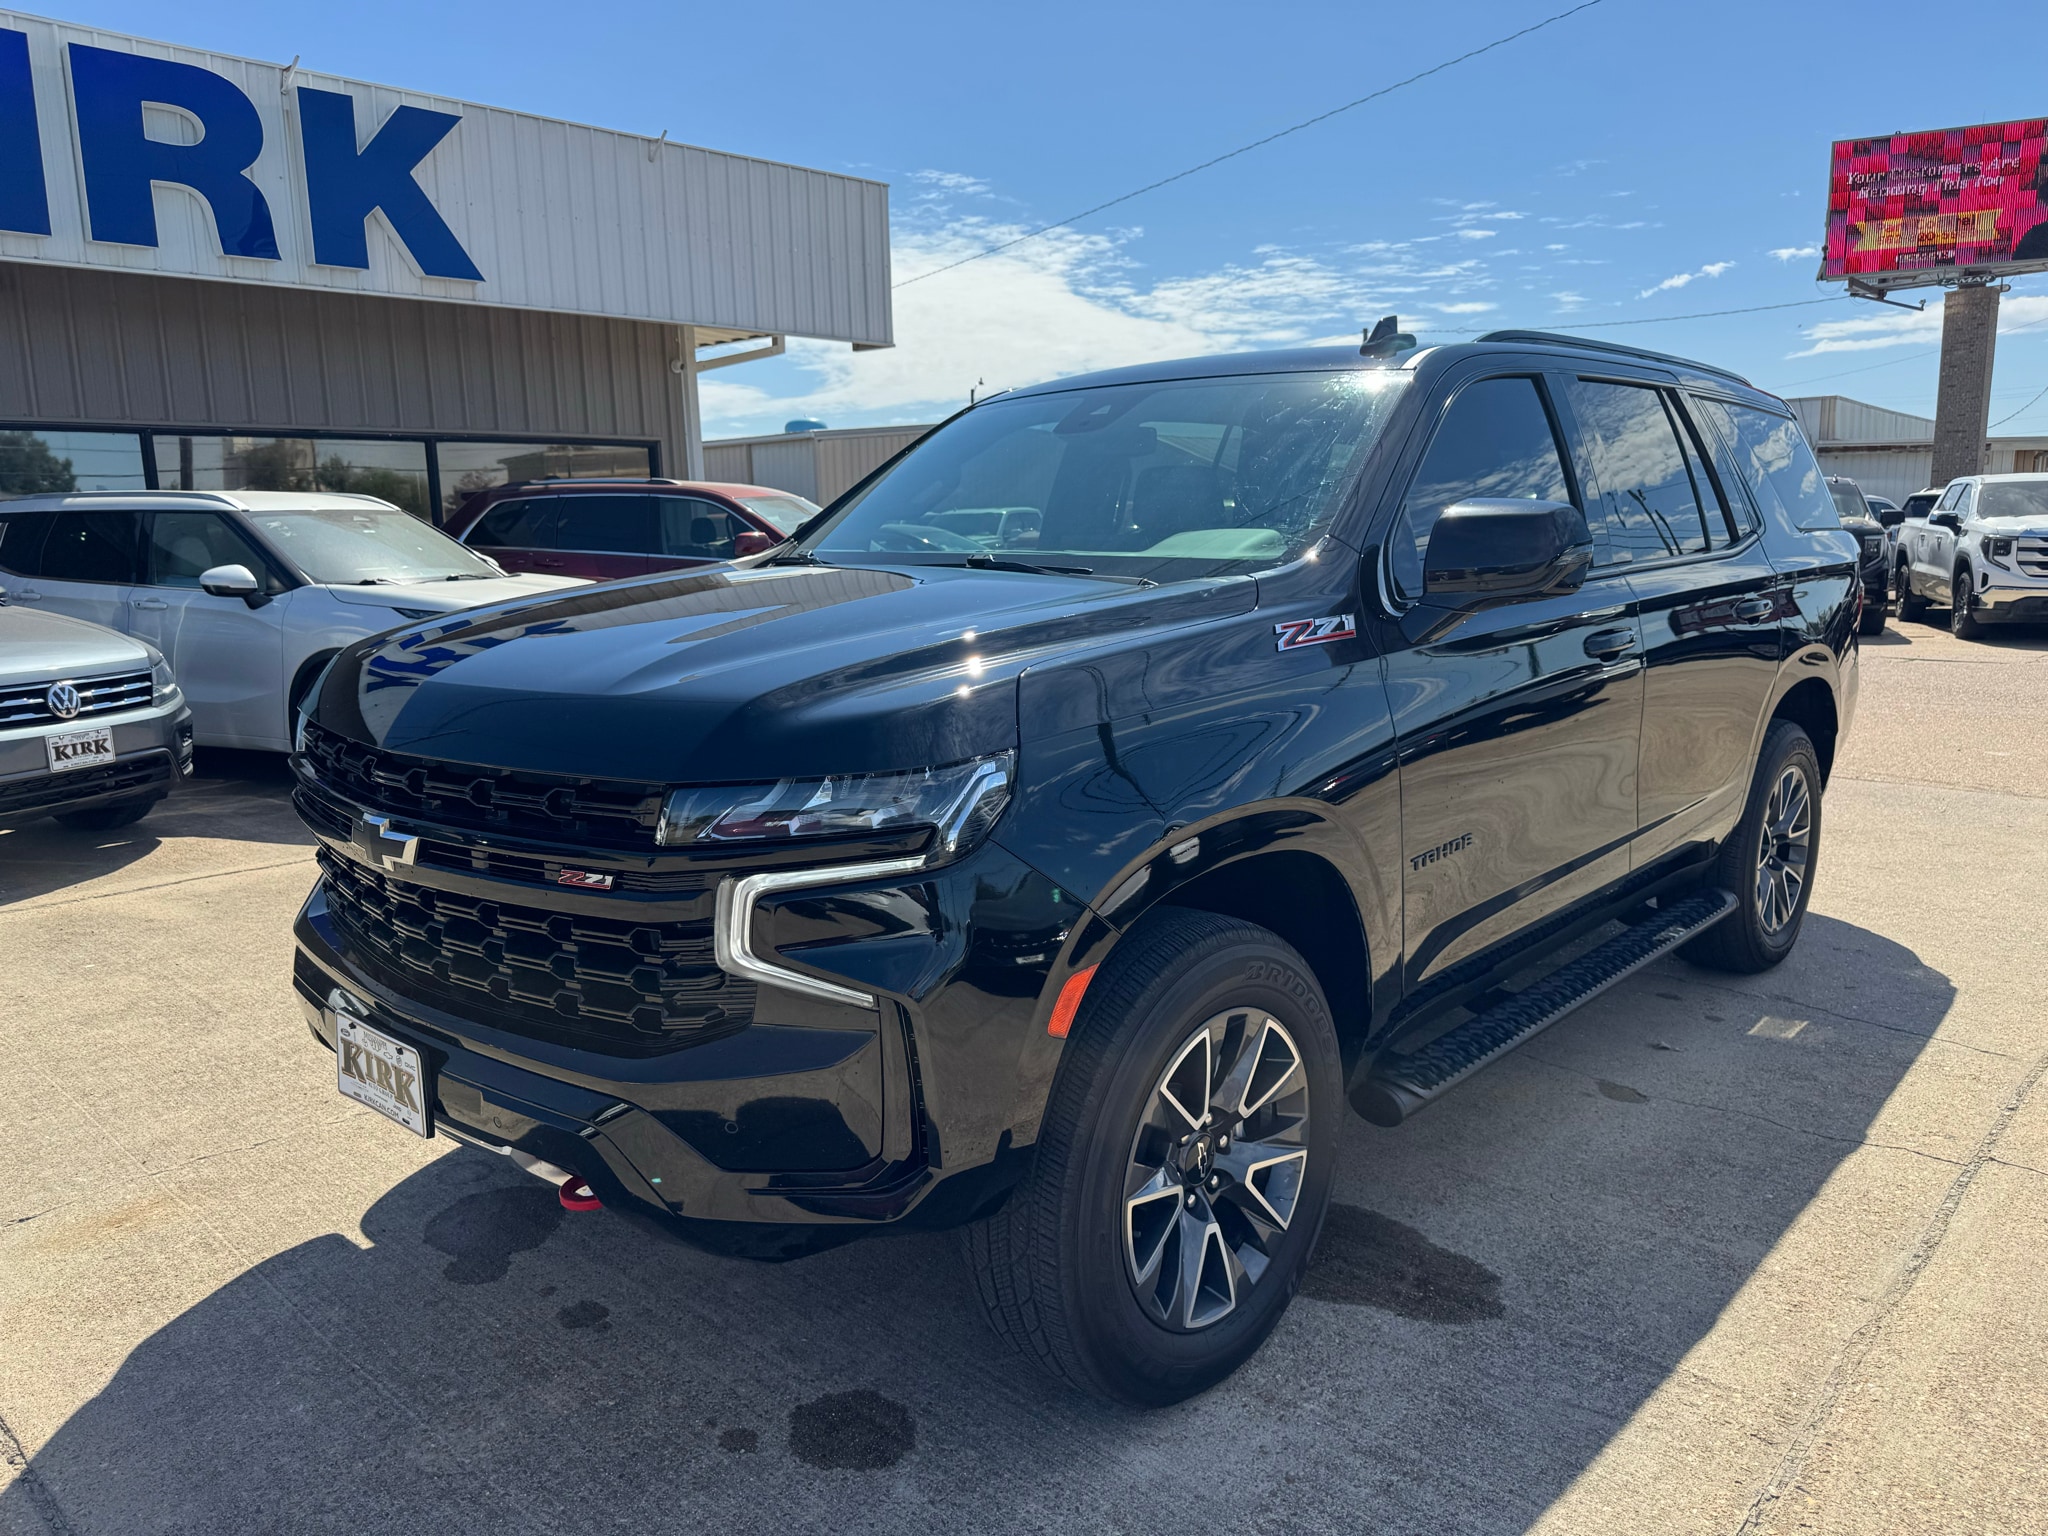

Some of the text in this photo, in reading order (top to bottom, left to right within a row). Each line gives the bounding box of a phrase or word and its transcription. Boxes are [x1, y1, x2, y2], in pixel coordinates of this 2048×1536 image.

[1846, 156, 2021, 185] Your Customers Are
[1856, 182, 1928, 199] Reading
[1934, 176, 1968, 192] This
[1941, 275, 1992, 285] LAMAR
[1274, 613, 1356, 652] Z71
[51, 738, 111, 763] KIRK
[1410, 832, 1473, 871] TAHOE
[558, 869, 615, 890] Z71
[341, 1037, 419, 1114] KIRK
